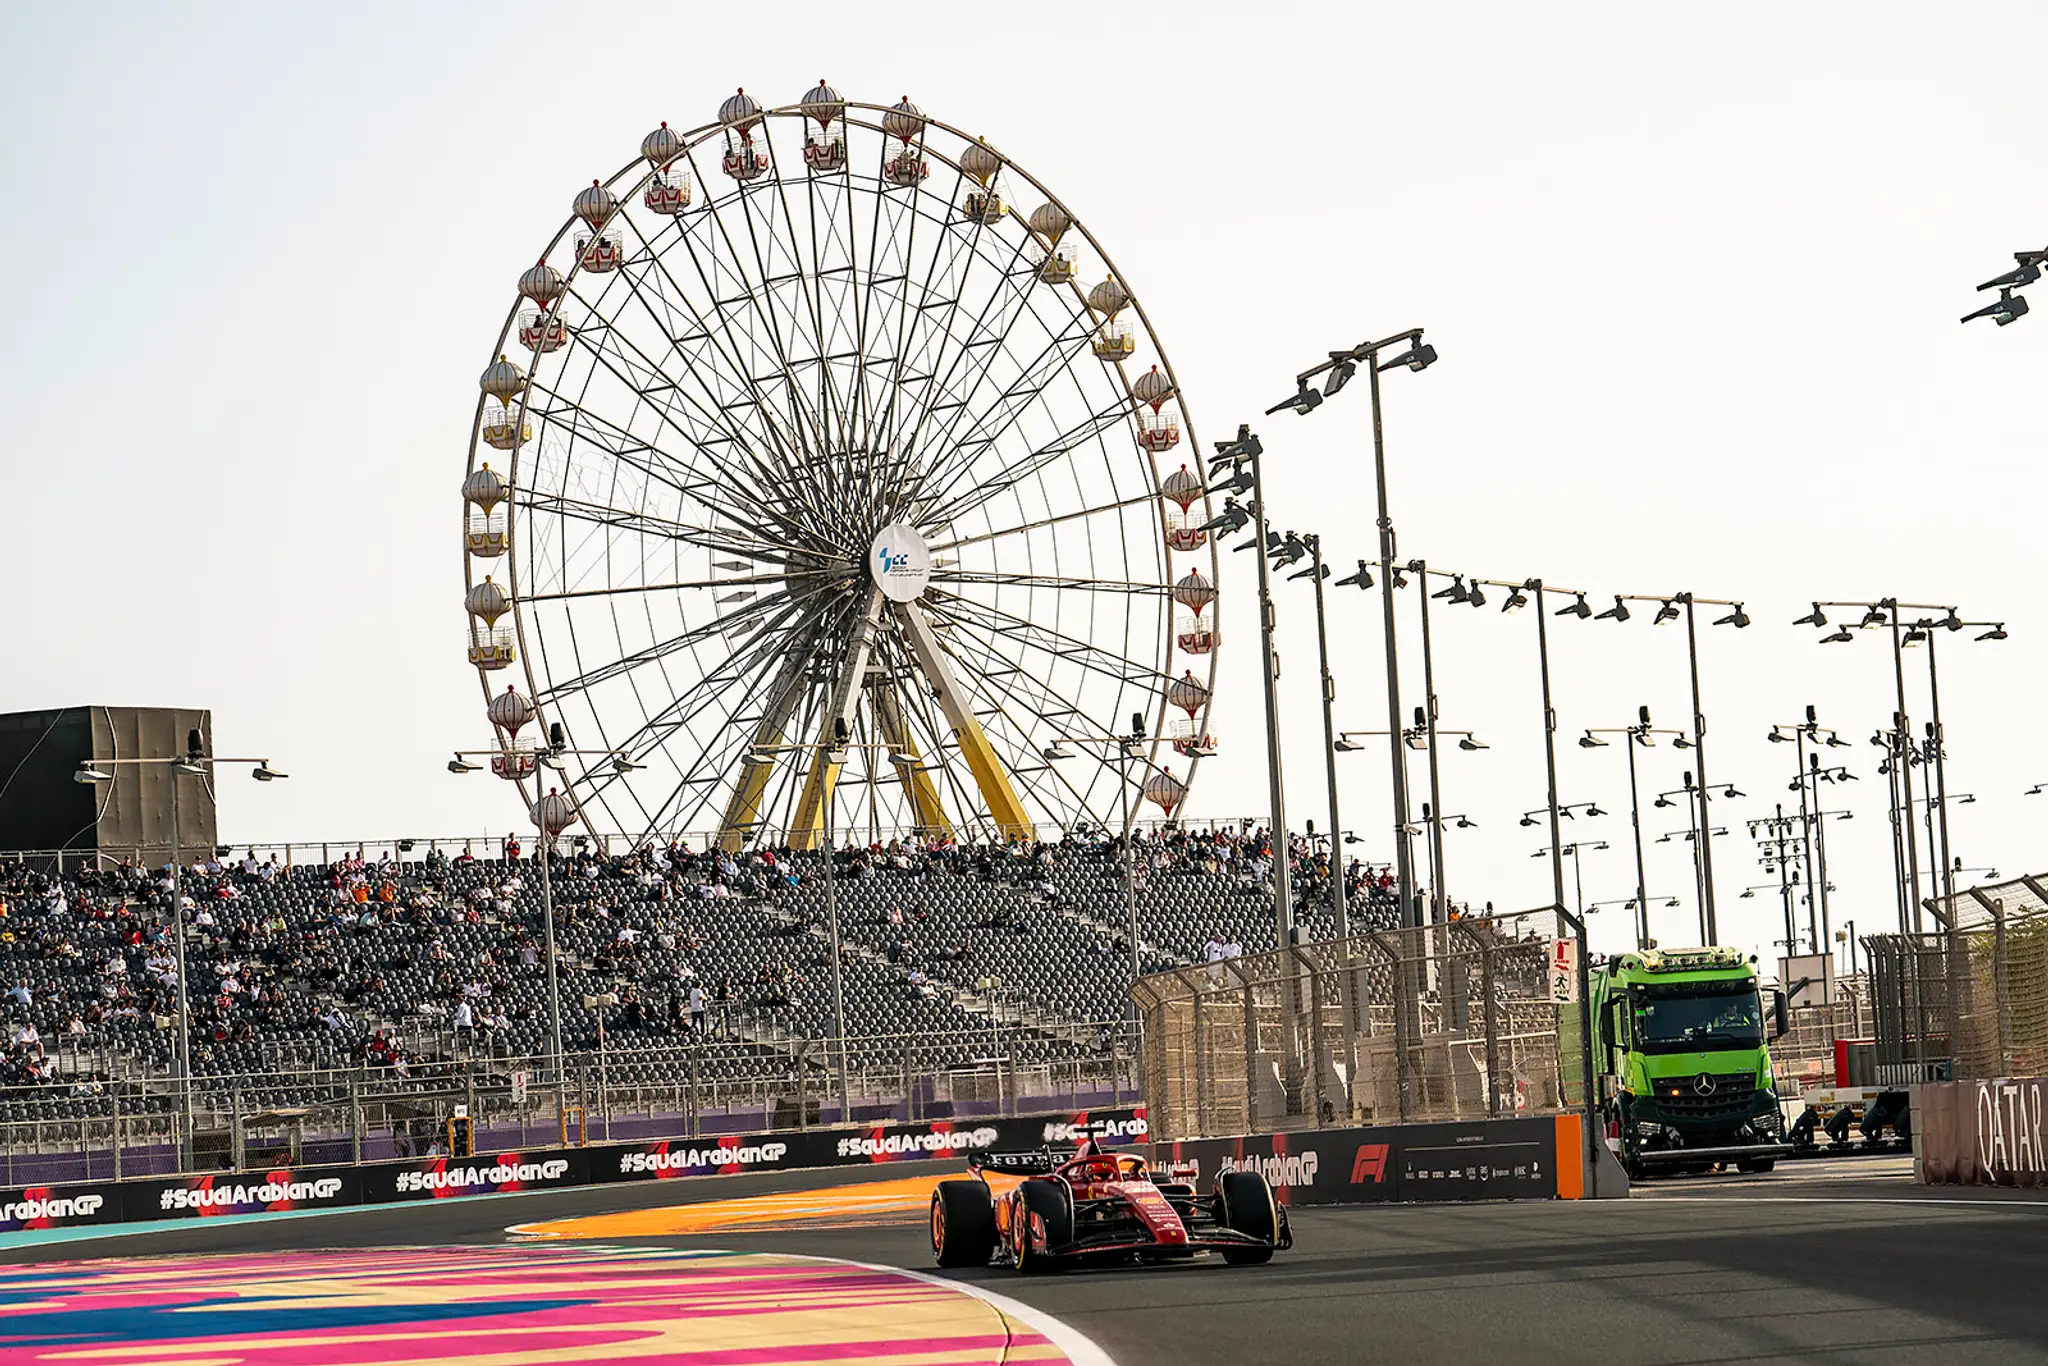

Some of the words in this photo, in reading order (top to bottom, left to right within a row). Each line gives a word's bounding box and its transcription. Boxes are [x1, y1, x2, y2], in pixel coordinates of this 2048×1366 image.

[1978, 1084, 2046, 1181] QATAR
[620, 1143, 787, 1173] #SaudiArabianGP
[1350, 1144, 1389, 1184] F1
[396, 1160, 568, 1192] #SaudiArabianGP
[0, 1194, 104, 1221] rabianGP
[160, 1178, 342, 1209] #SaudiArabianGP
